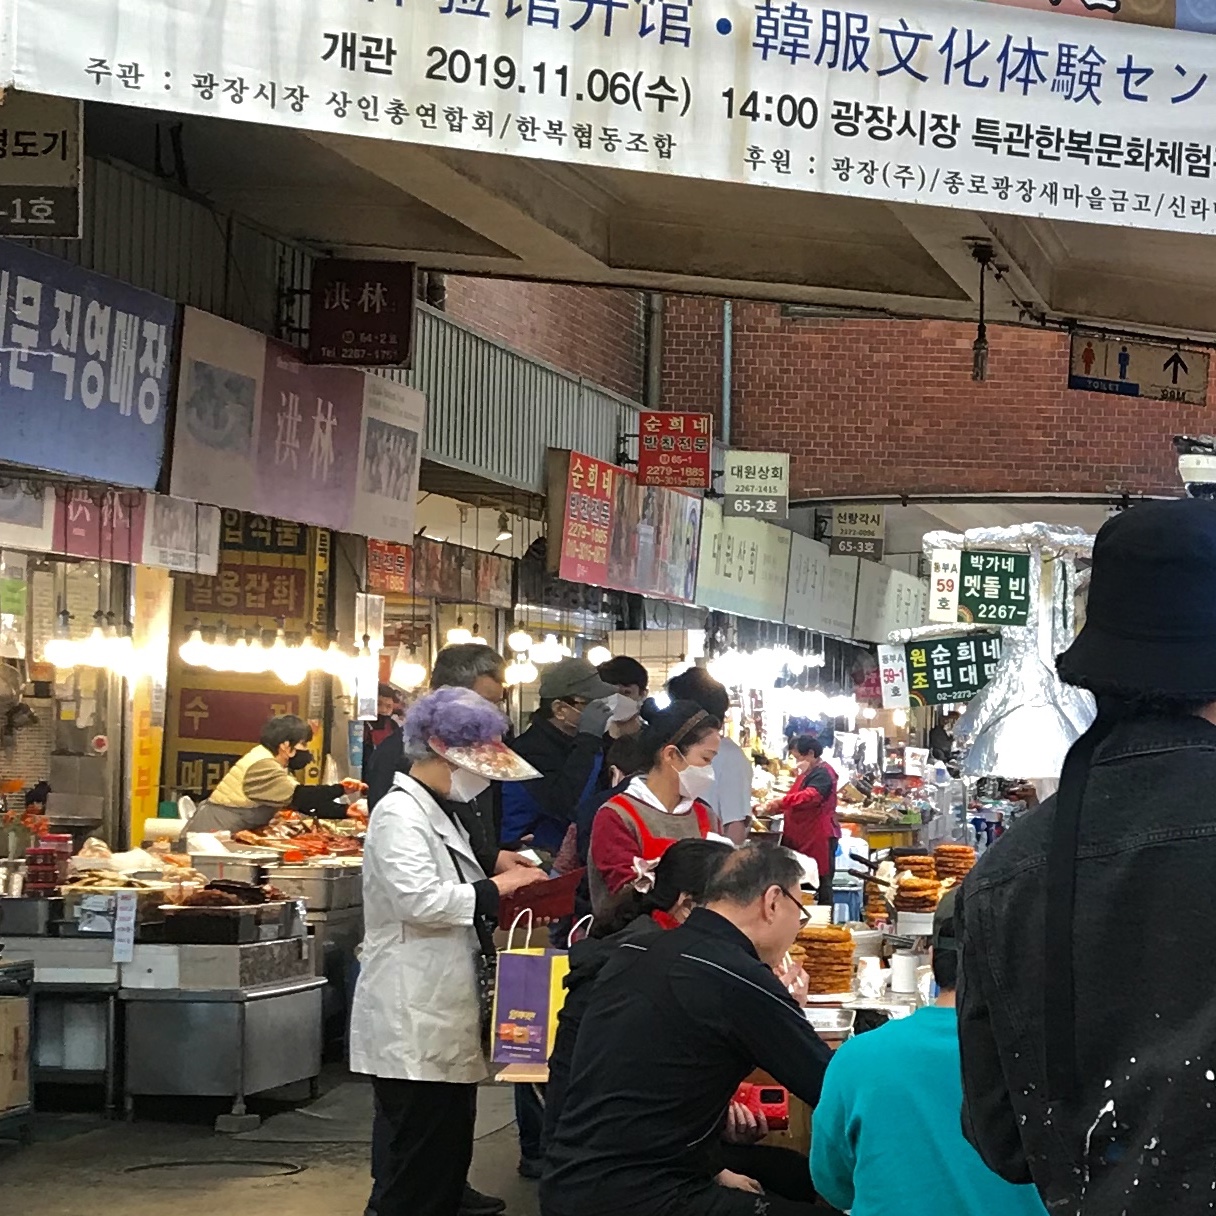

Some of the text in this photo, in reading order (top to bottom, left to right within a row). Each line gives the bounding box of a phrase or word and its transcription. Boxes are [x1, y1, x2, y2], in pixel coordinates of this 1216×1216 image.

[322, 30, 397, 76] 개관
[426, 46, 692, 117] 2019.11.06(수)
[722, 87, 818, 129] 14:00
[831, 97, 961, 149] 광장시장
[85, 56, 145, 91] 주관
[192, 71, 309, 114] 광장시장
[324, 89, 677, 160] 상인총연합회/한복협동조합
[744, 143, 791, 175] 후원
[51, 289, 167, 424] 직영매장
[644, 416, 708, 434] 순희네
[644, 435, 708, 453] 반찬전문
[572, 458, 613, 499] 순희네
[731, 465, 783, 480] 대원상회
[734, 500, 777, 513] 65-2호
[838, 541, 875, 553] 65-3호
[713, 533, 759, 584] 대원상회
[934, 562, 958, 573] 동부A
[970, 555, 1015, 573] 박가네
[936, 578, 955, 592] 59
[1009, 577, 1026, 600] 빈
[936, 596, 950, 610] 호
[978, 604, 1026, 619] 2267-
[931, 638, 1000, 666] 순희네
[883, 667, 905, 683] 59-1
[891, 686, 900, 697] 호
